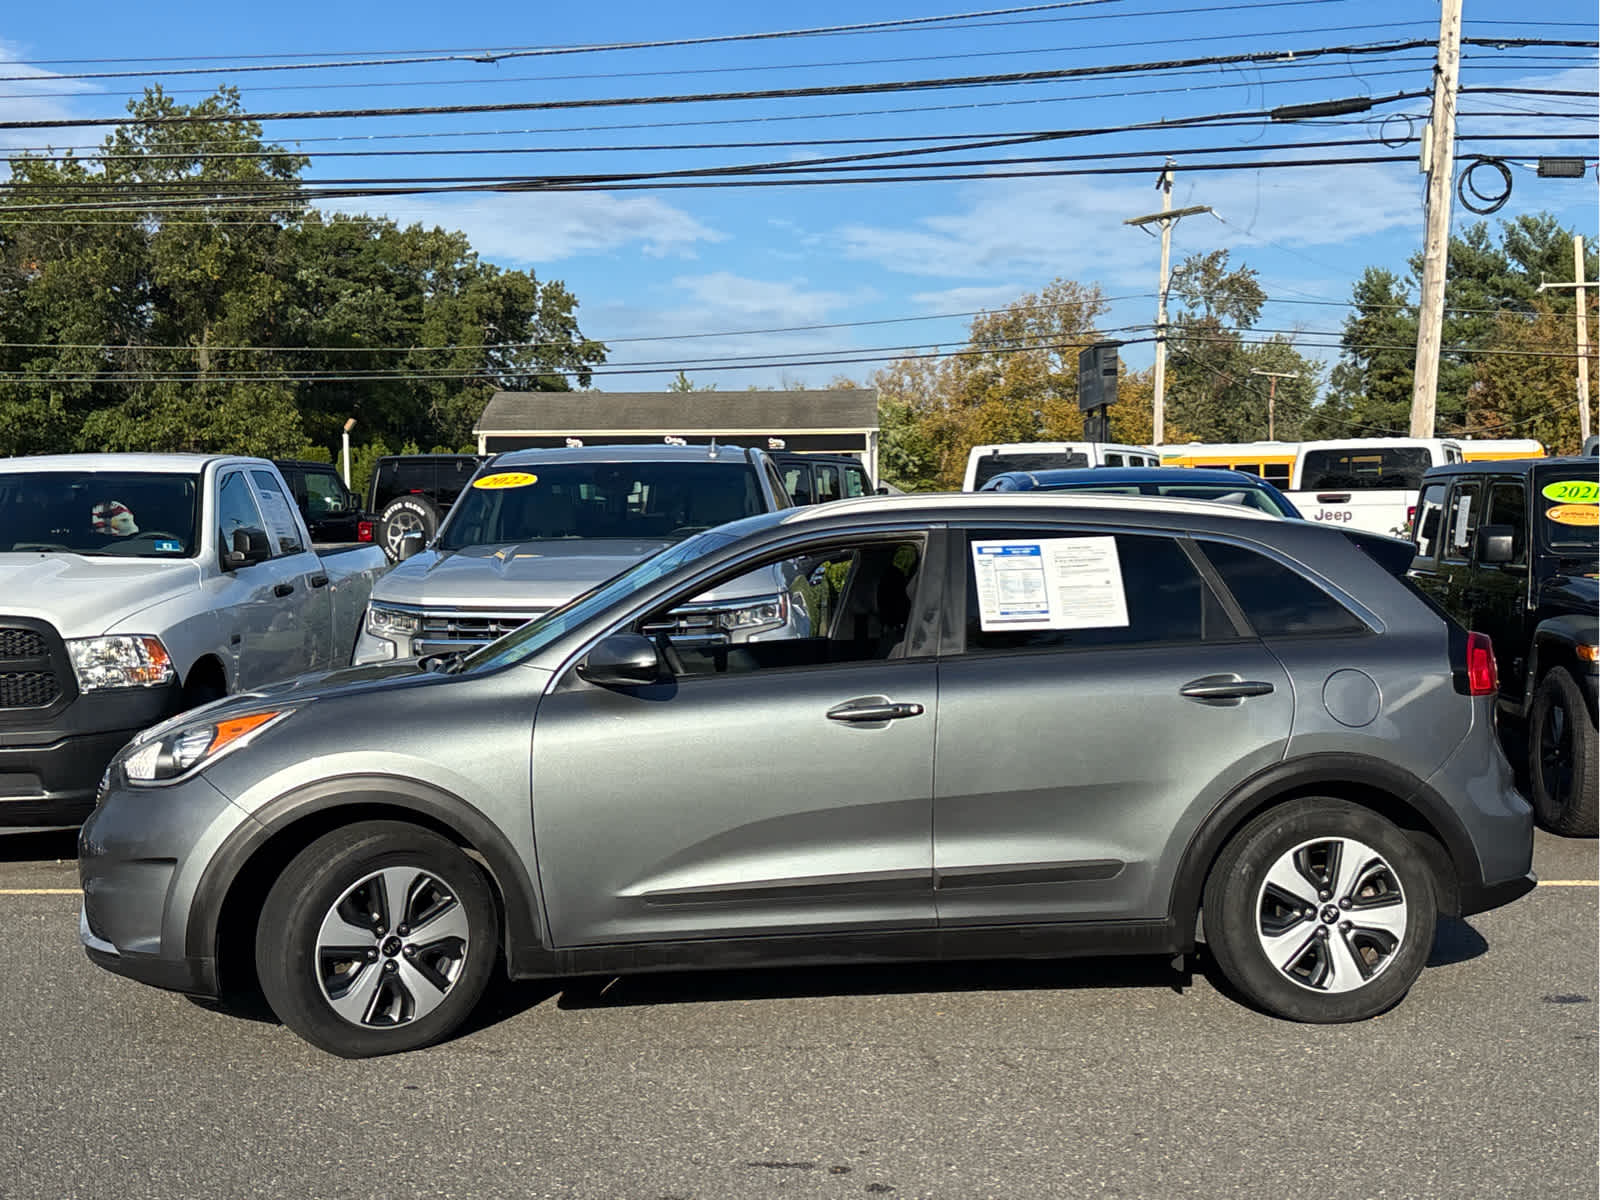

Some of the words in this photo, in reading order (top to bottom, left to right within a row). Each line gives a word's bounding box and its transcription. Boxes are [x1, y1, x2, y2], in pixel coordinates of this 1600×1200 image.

[481, 475, 530, 487] 2022
[1556, 486, 1599, 499] 2021
[1314, 508, 1353, 523] Jeep
